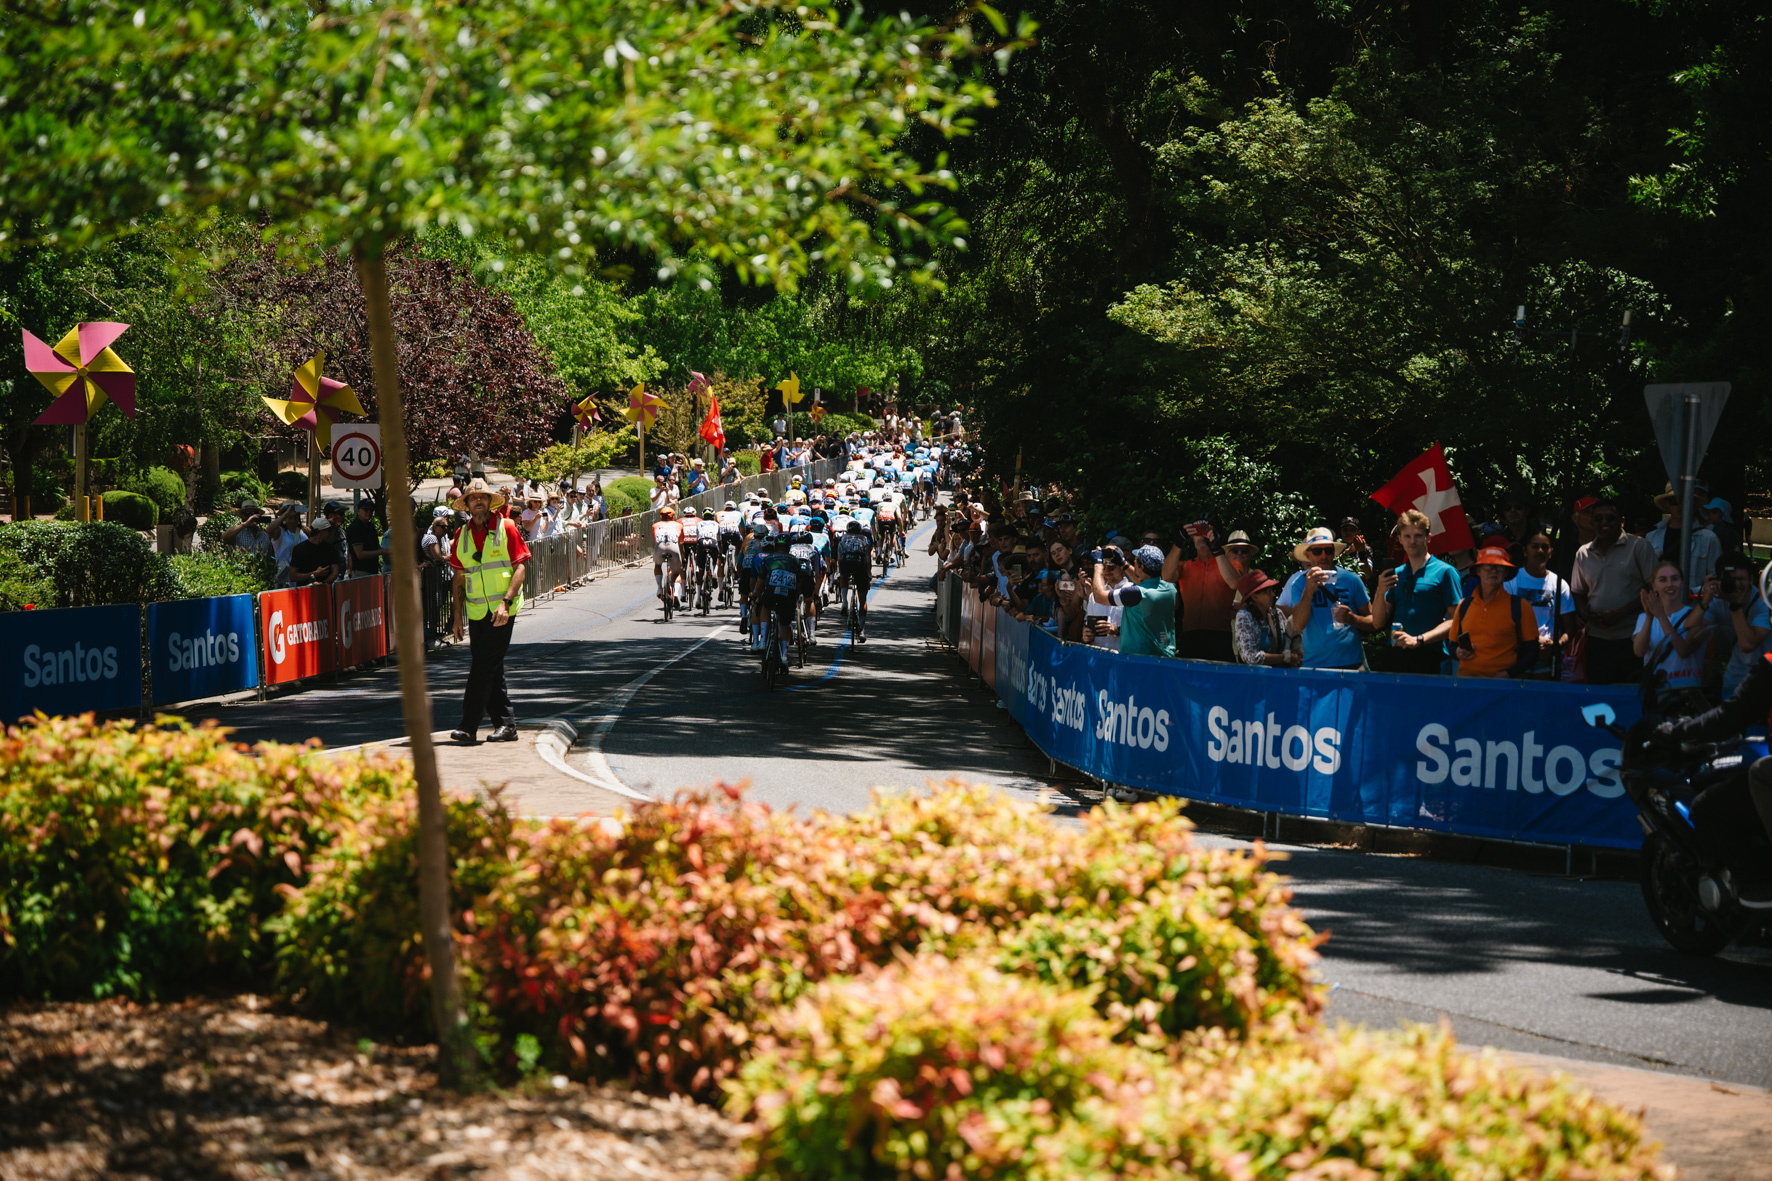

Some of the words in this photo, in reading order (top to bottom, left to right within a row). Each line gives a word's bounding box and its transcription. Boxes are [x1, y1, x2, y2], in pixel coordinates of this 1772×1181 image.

[341, 447, 372, 467] 40
[268, 610, 286, 664] G
[287, 619, 329, 646] GATORADE
[353, 607, 382, 631] GATORADE
[23, 641, 118, 688] Santos
[168, 628, 240, 672] Santos
[1051, 676, 1086, 732] Santos
[1095, 688, 1170, 753] Santos
[1207, 705, 1342, 775] Santos
[1415, 722, 1627, 799] Santos
